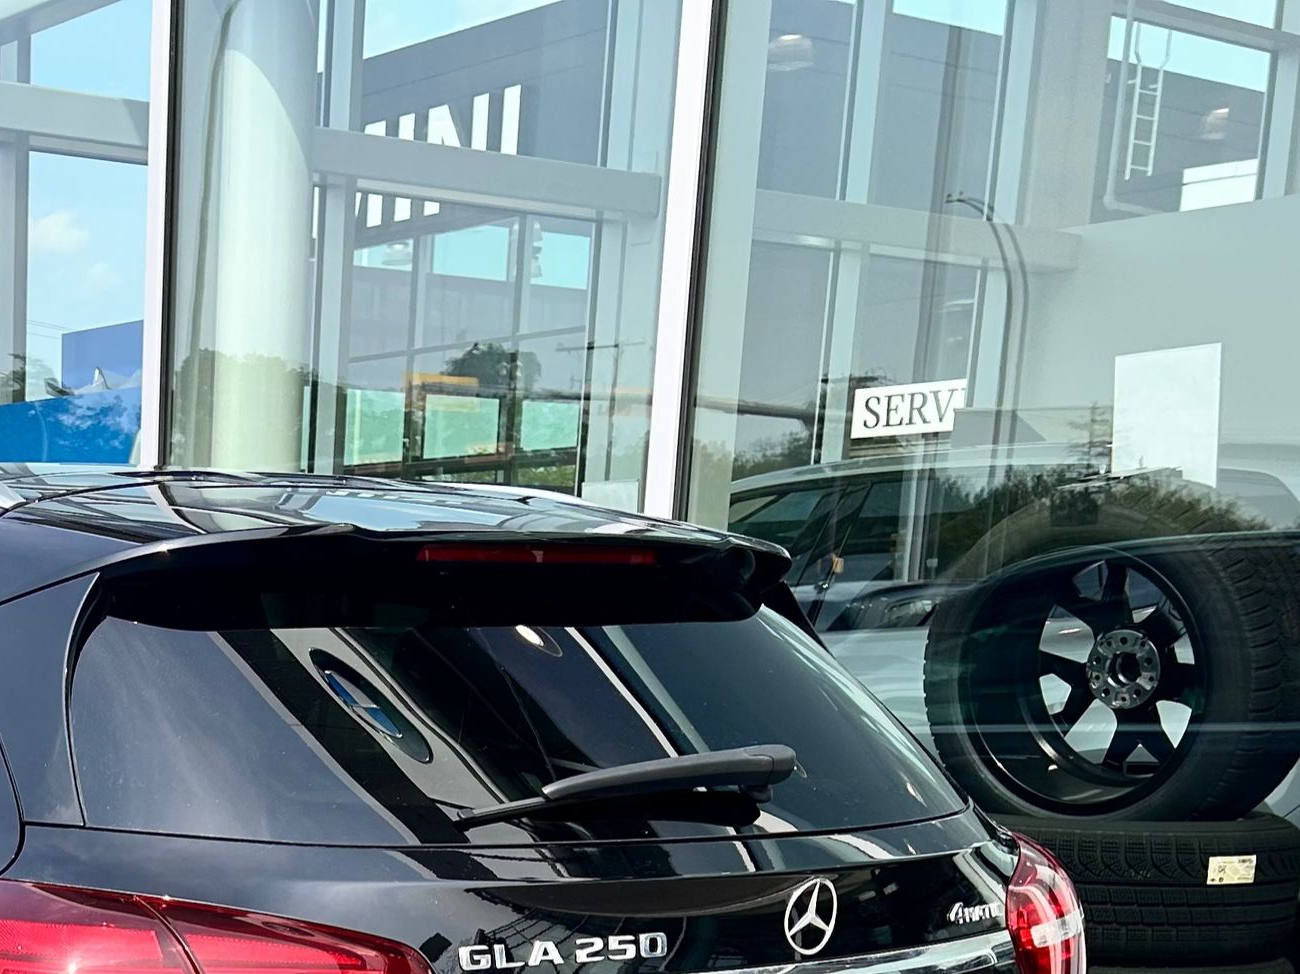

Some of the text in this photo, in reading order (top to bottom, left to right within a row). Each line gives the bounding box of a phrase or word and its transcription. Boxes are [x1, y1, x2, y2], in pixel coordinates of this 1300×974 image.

[863, 388, 967, 429] SERV
[458, 932, 668, 972] GLA 250
